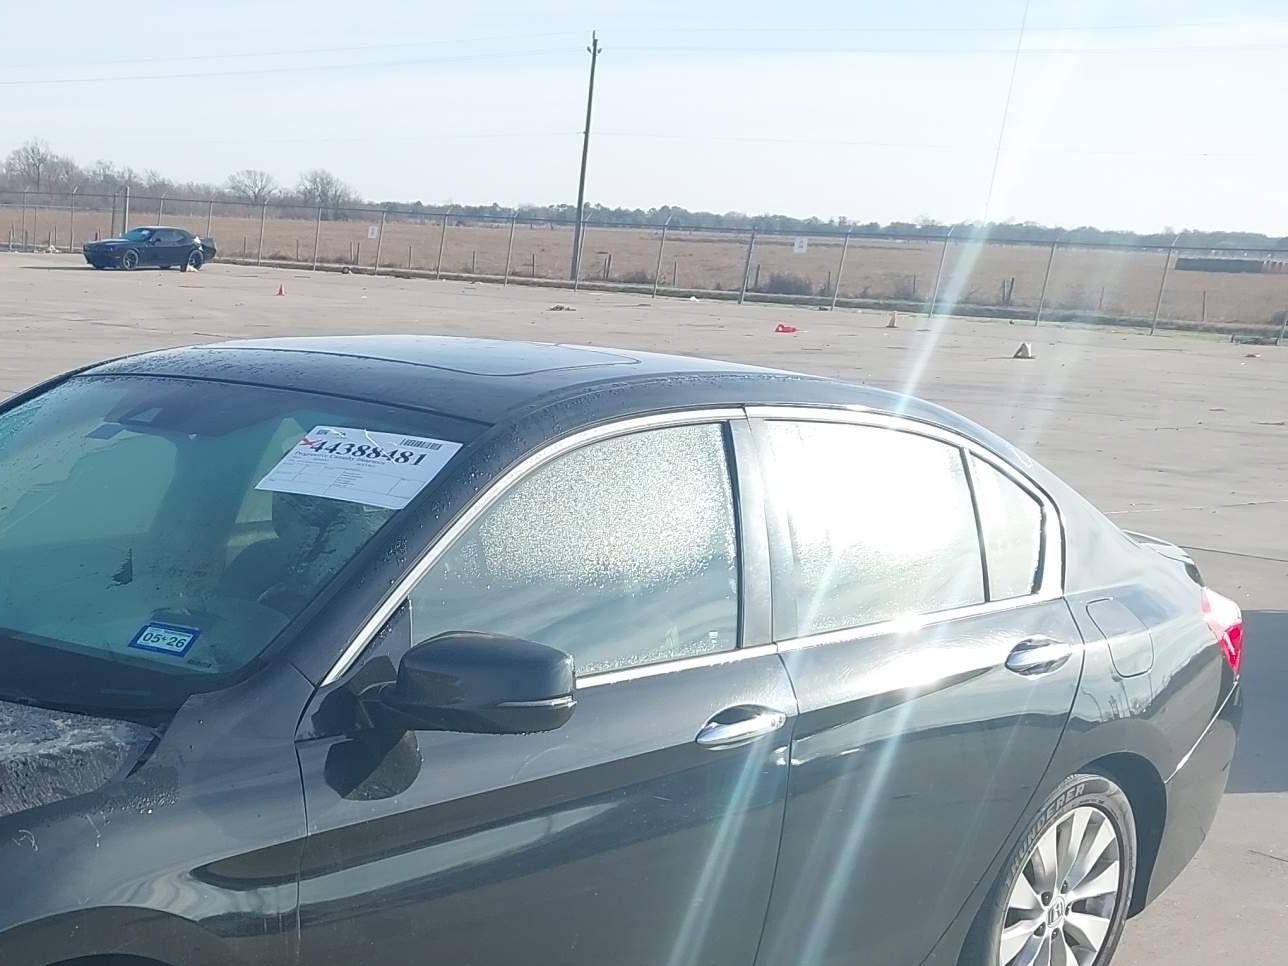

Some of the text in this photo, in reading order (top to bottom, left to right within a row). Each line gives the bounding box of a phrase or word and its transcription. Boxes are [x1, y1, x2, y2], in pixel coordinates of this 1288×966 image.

[310, 440, 427, 467] 44388481
[143, 632, 163, 644] 05
[166, 636, 187, 648] 26
